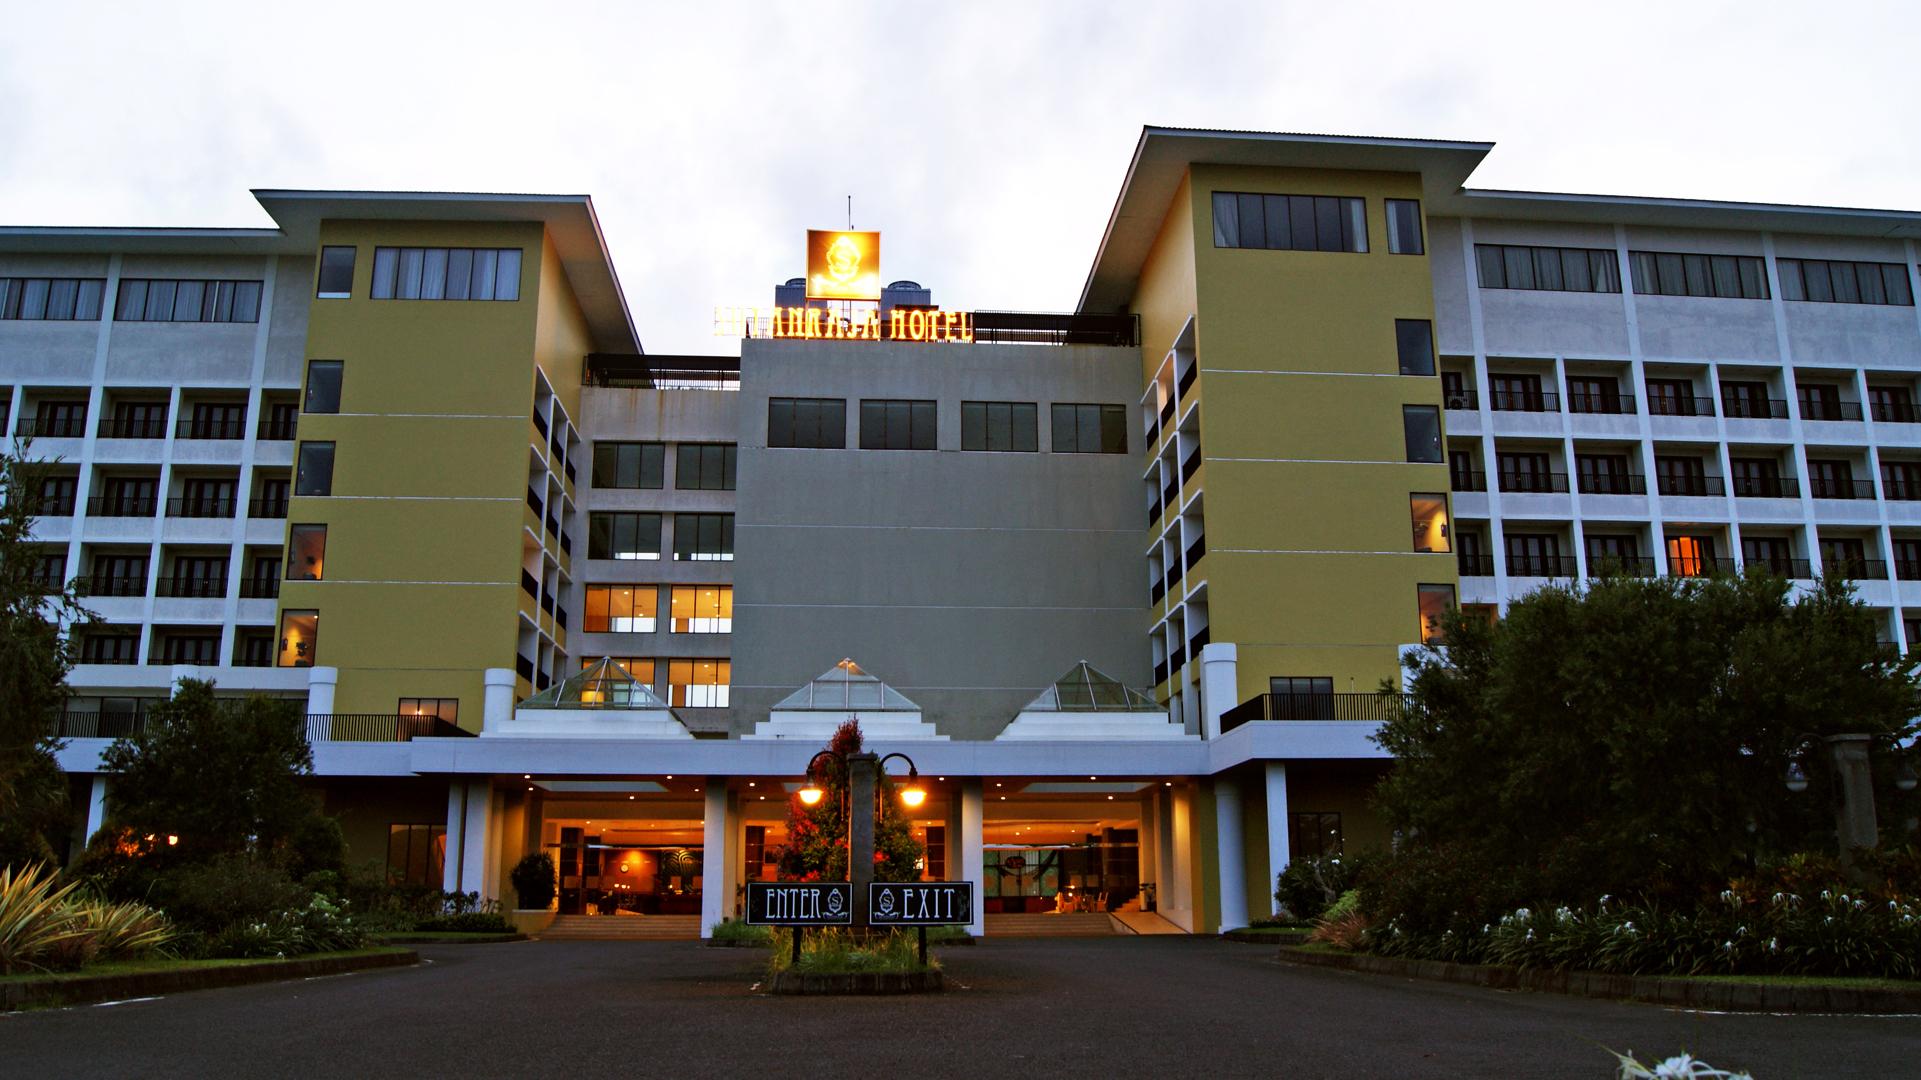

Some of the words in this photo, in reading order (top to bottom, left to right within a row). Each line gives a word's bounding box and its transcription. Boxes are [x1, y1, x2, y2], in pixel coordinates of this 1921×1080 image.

[890, 309, 973, 341] HOTEL
[766, 888, 821, 919] ENTER
[903, 888, 955, 919] EXIT
